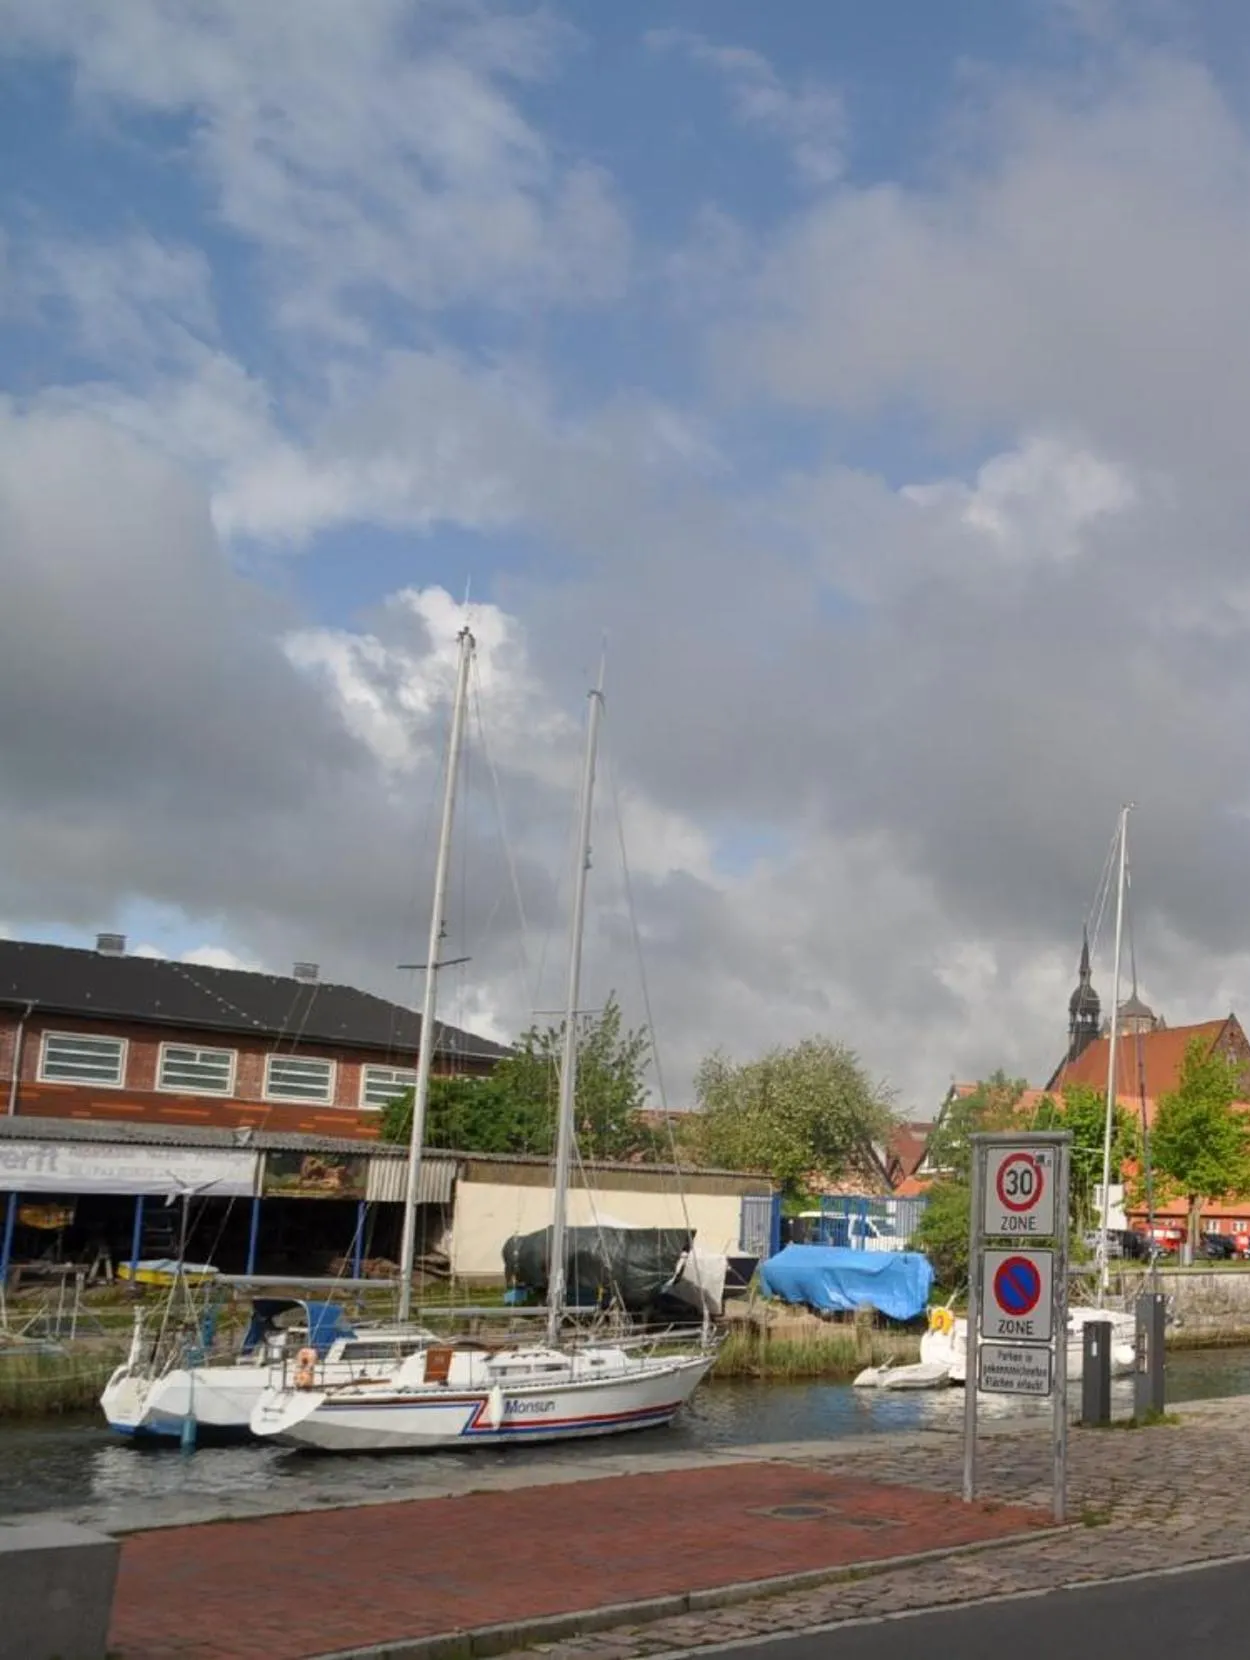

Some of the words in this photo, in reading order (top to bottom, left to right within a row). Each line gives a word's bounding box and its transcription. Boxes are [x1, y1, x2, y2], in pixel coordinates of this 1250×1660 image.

[1006, 1169, 1033, 1195] 30
[1001, 1216, 1037, 1231] ZONE
[998, 1320, 1034, 1336] ZONE
[504, 1400, 556, 1415] Monsun
